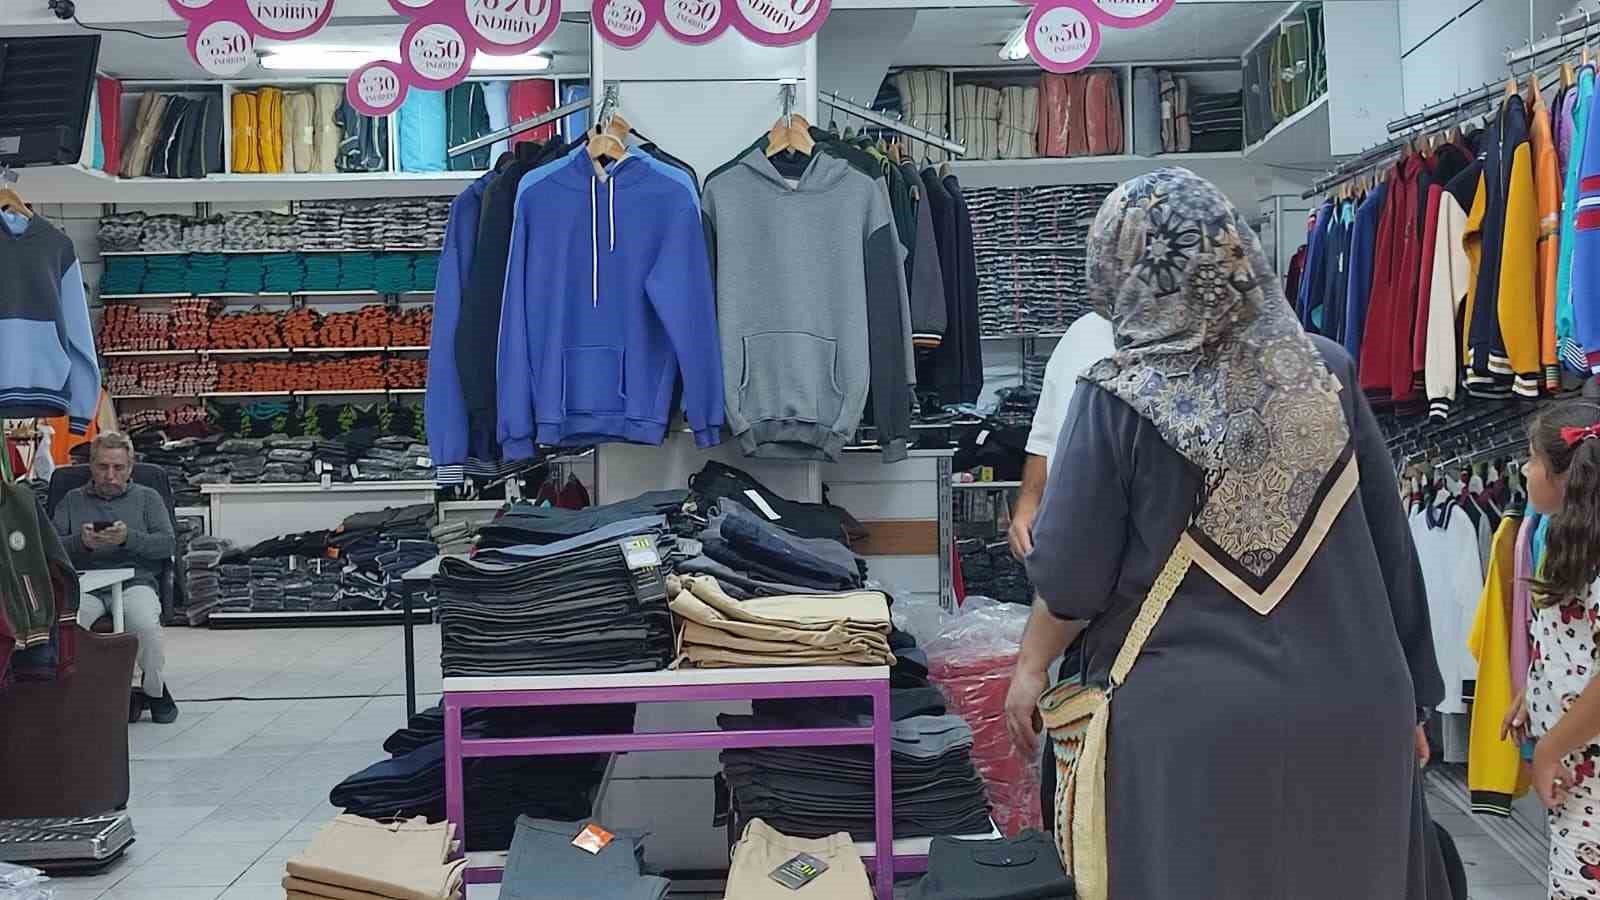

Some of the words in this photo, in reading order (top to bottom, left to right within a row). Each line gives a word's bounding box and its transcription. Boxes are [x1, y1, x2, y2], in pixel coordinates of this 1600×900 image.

[257, 2, 319, 19] İNDİRİM
[474, 10, 537, 35] İNDİRİM
[1040, 21, 1085, 43] %50
[201, 34, 246, 56] %50
[414, 39, 460, 60] %50
